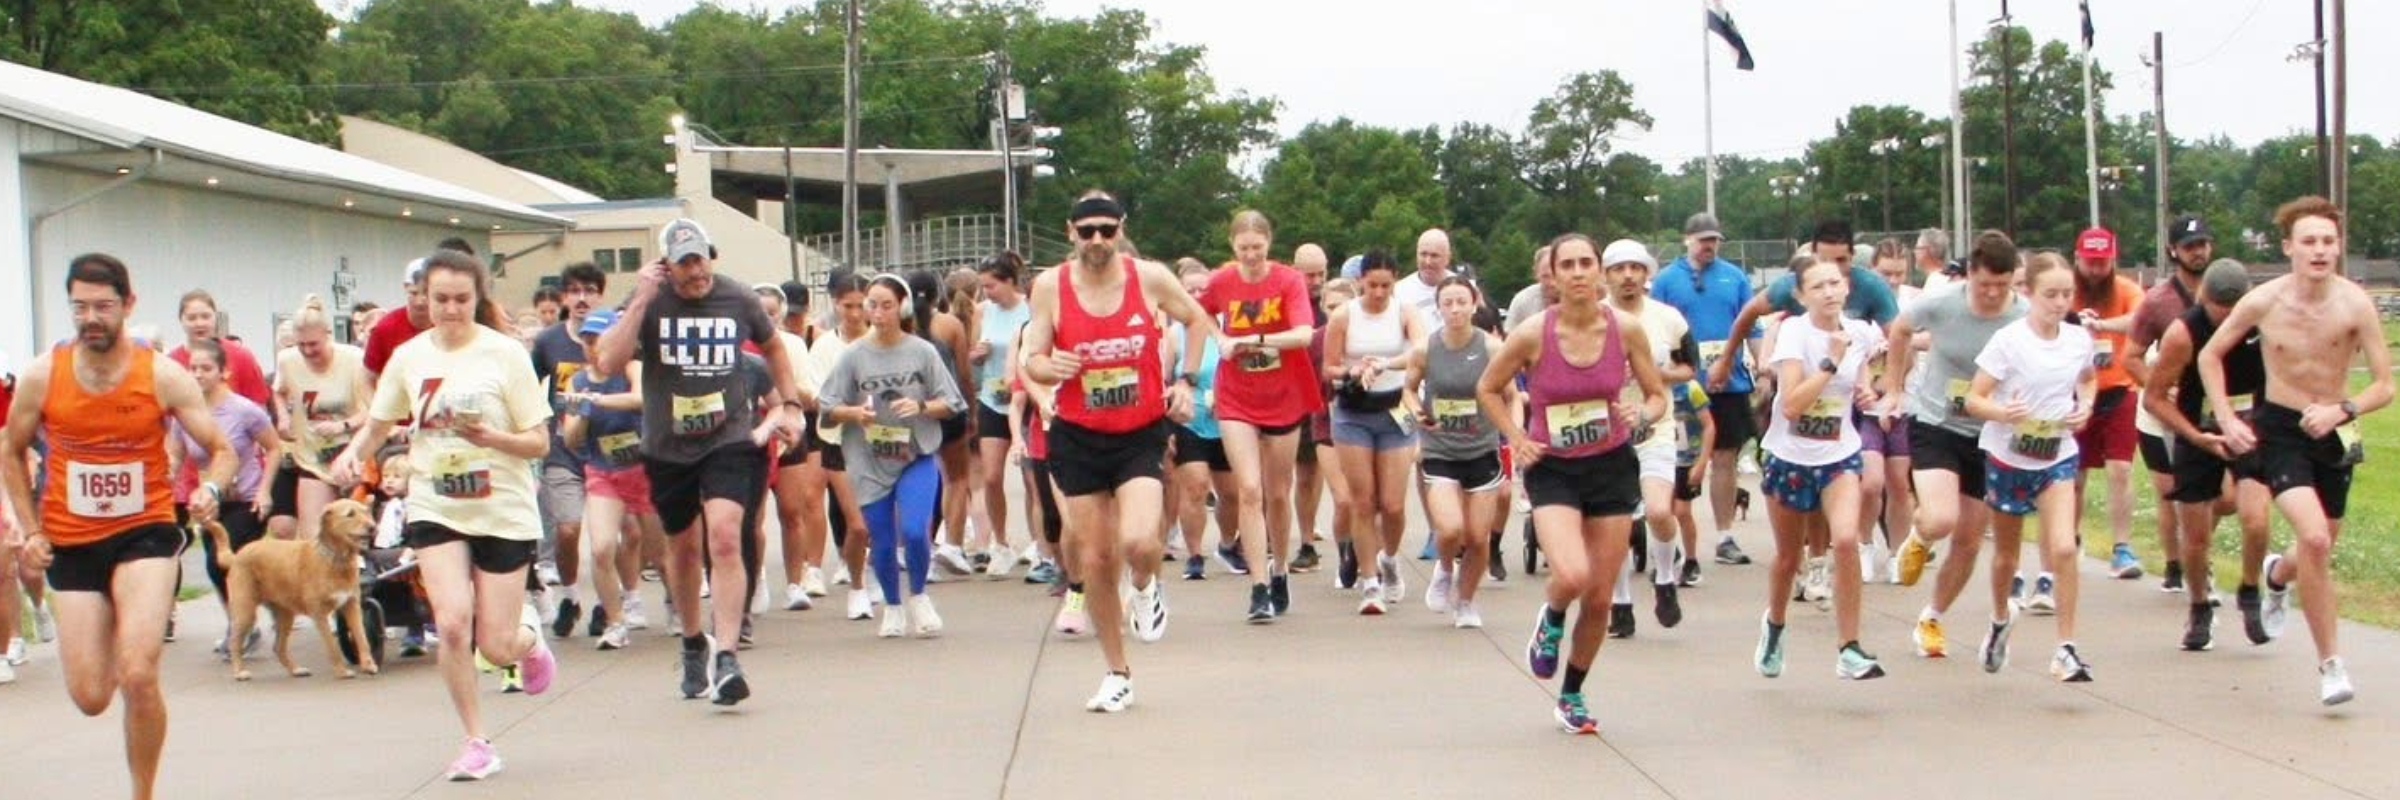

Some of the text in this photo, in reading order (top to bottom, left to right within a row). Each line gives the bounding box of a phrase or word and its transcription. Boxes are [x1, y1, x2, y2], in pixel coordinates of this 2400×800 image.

[1092, 386, 1130, 407] 540
[683, 413, 714, 434] 531
[1560, 421, 1599, 447] 516
[1797, 415, 1834, 436] 525
[78, 471, 132, 498] 1659
[442, 473, 477, 493] 511
